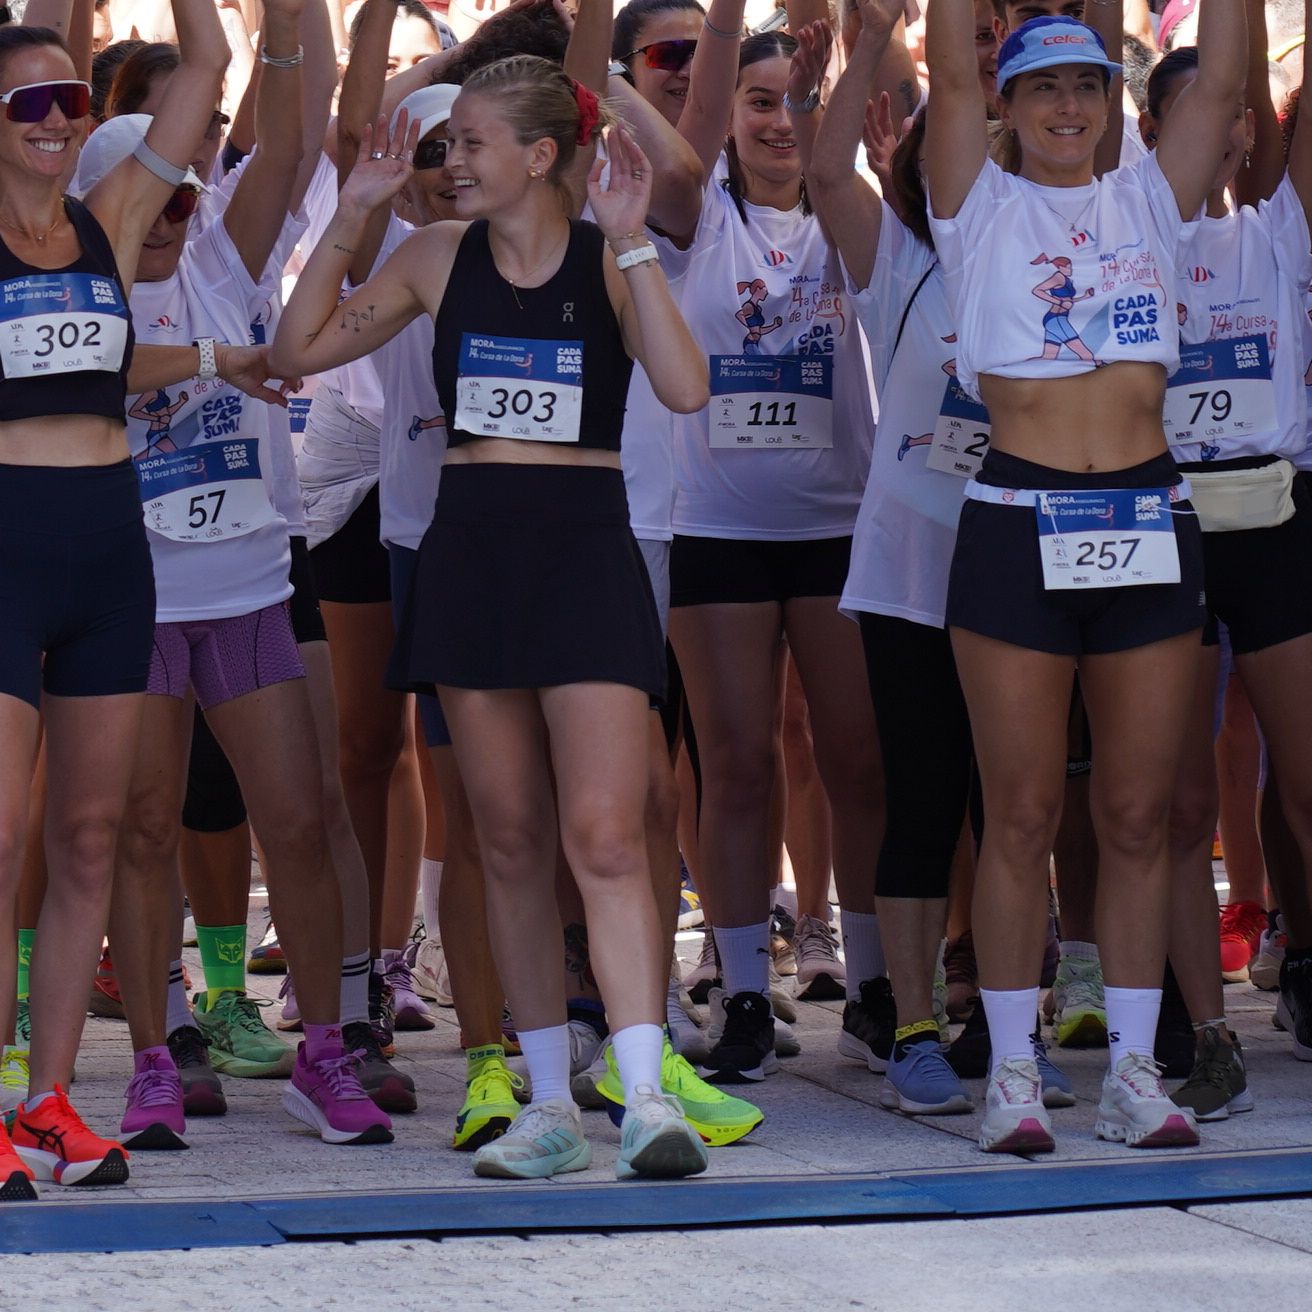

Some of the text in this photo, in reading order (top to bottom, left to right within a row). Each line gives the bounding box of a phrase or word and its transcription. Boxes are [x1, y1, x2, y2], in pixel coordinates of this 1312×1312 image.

[4, 280, 31, 292] MORA
[91, 280, 111, 288] CADA
[92, 287, 114, 296] PAS
[95, 296, 117, 305] SUMA
[1114, 293, 1157, 311] CADA
[1113, 308, 1158, 329] PAS
[1236, 314, 1267, 331] Cursa
[34, 321, 101, 357] 302
[1116, 327, 1161, 345] SUMA
[470, 339, 495, 348] MORA
[1234, 343, 1258, 351] CADA
[557, 348, 582, 356] CADA
[1235, 350, 1259, 360] PAS
[557, 355, 582, 365] PAS
[1237, 359, 1261, 368] SUMA
[557, 364, 582, 374] SUMA
[801, 369, 823, 377] PAS
[802, 377, 823, 385] SUMA
[488, 388, 557, 423] 303
[1189, 390, 1232, 425] 79
[747, 401, 798, 426] 111
[223, 443, 247, 453] CADA
[225, 452, 247, 461] PAS
[139, 459, 167, 471] MORA
[227, 460, 250, 470] SUMA
[1048, 496, 1076, 504] MORA
[188, 489, 227, 529] 57
[1135, 512, 1161, 521] SUMA
[1076, 538, 1141, 571] 257
